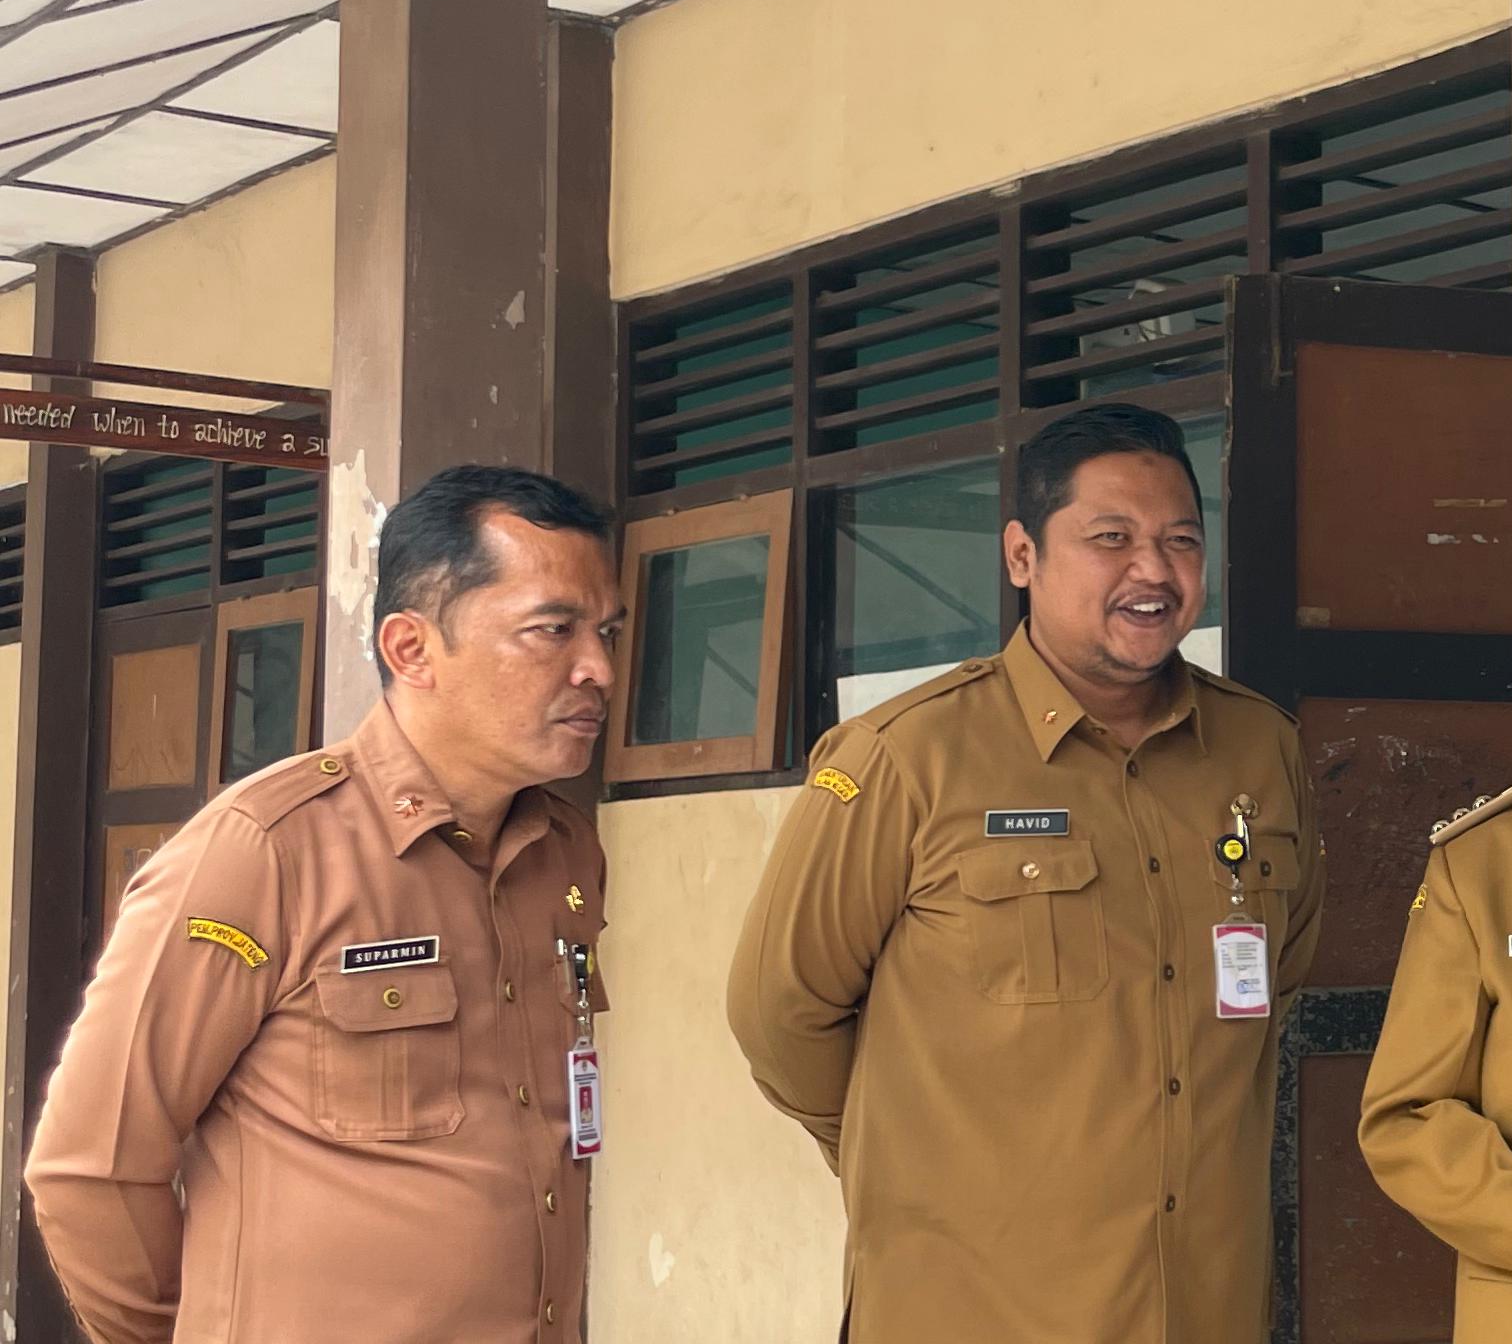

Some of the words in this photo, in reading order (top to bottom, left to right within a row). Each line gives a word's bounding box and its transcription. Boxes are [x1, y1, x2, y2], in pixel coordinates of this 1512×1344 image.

[3, 402, 77, 429] needed
[93, 407, 146, 436] when
[156, 414, 180, 439] to
[194, 418, 267, 450] achieve
[280, 433, 296, 453] a
[1005, 817, 1050, 830] HAVID
[354, 945, 427, 963] SUPARMIN
